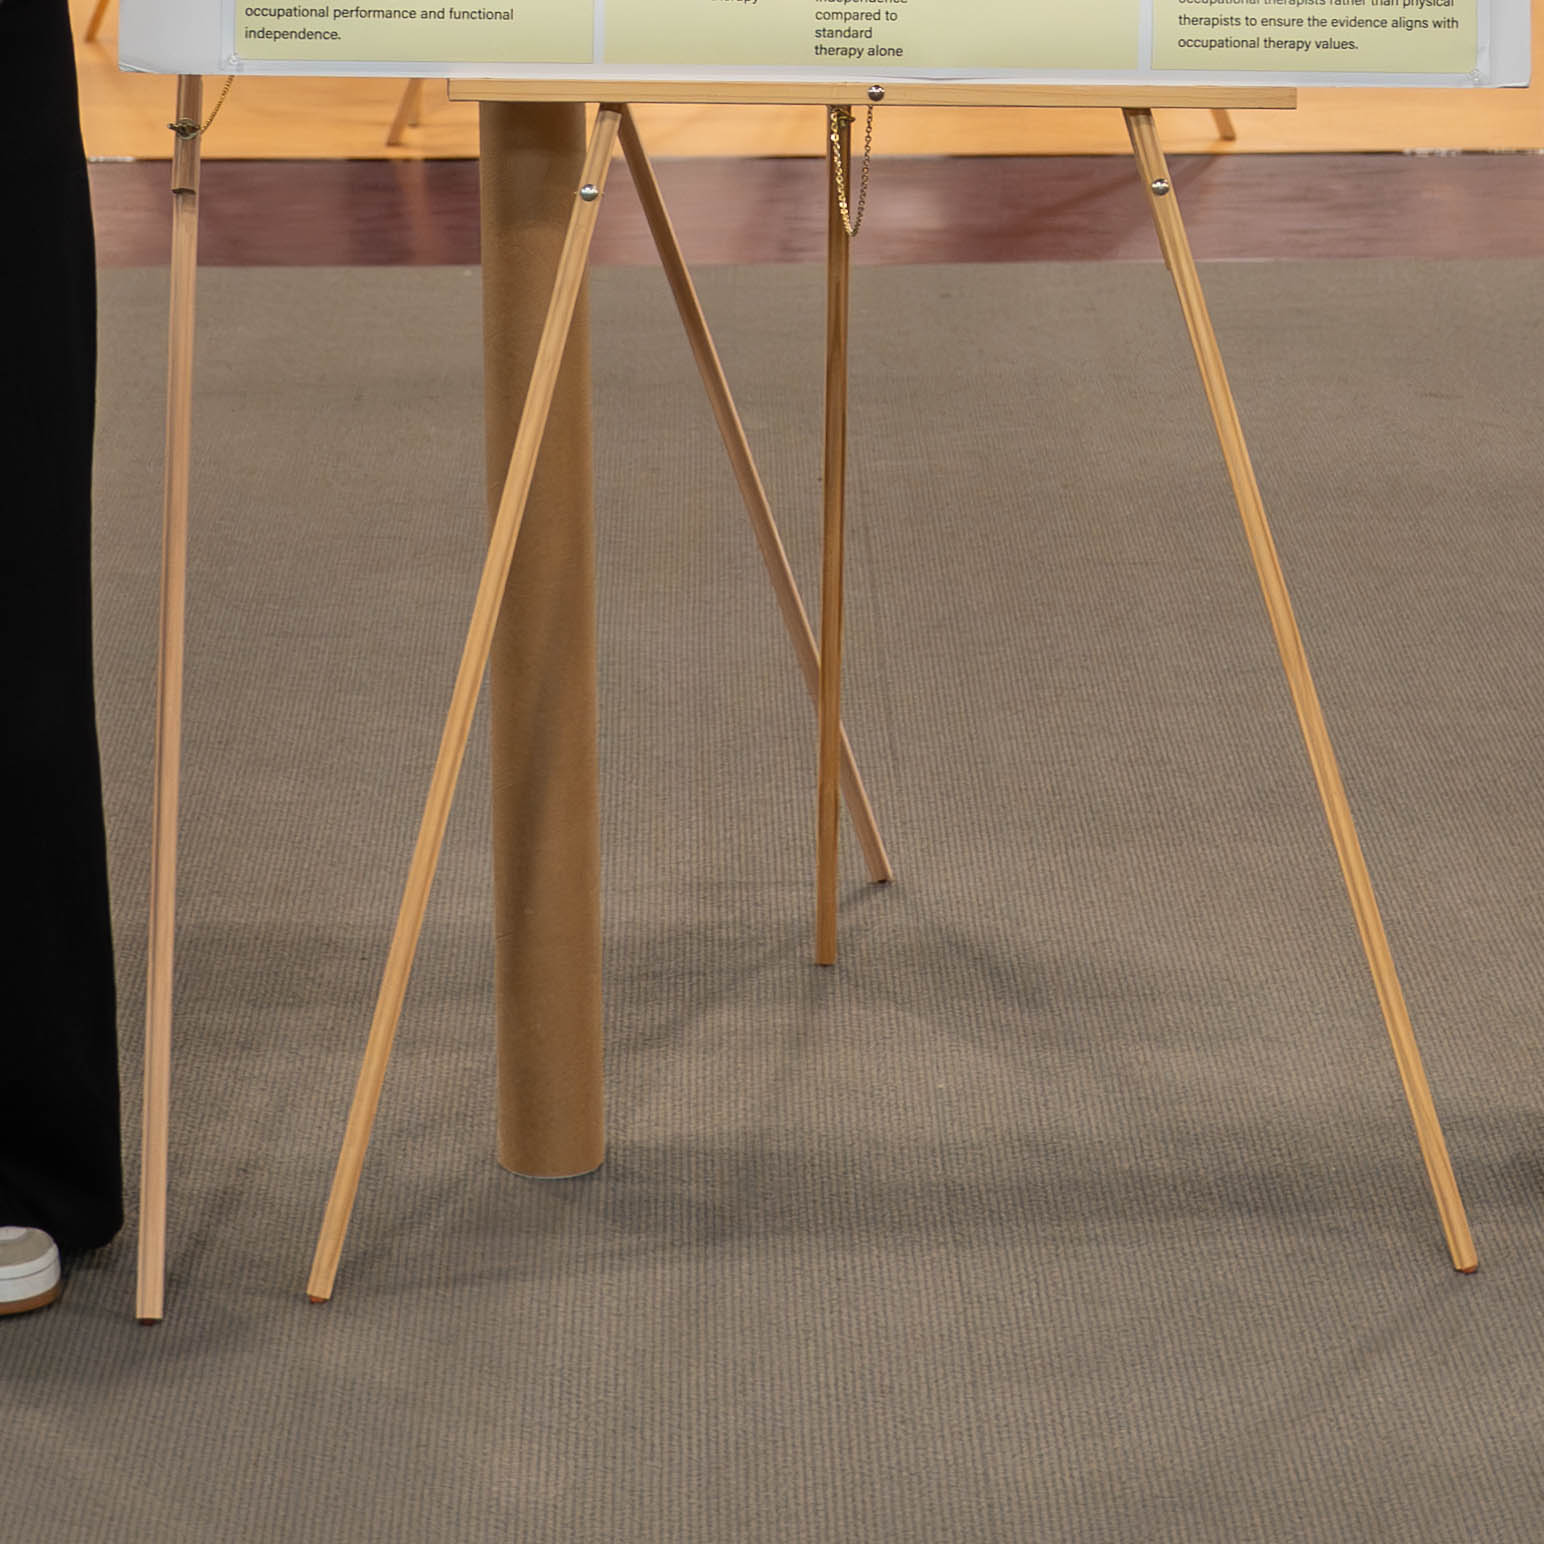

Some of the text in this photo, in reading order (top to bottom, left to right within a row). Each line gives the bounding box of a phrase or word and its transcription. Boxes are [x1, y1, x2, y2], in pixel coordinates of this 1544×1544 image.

[245, 27, 341, 42] independence.
[1178, 36, 1359, 53] occupational therapy values.
